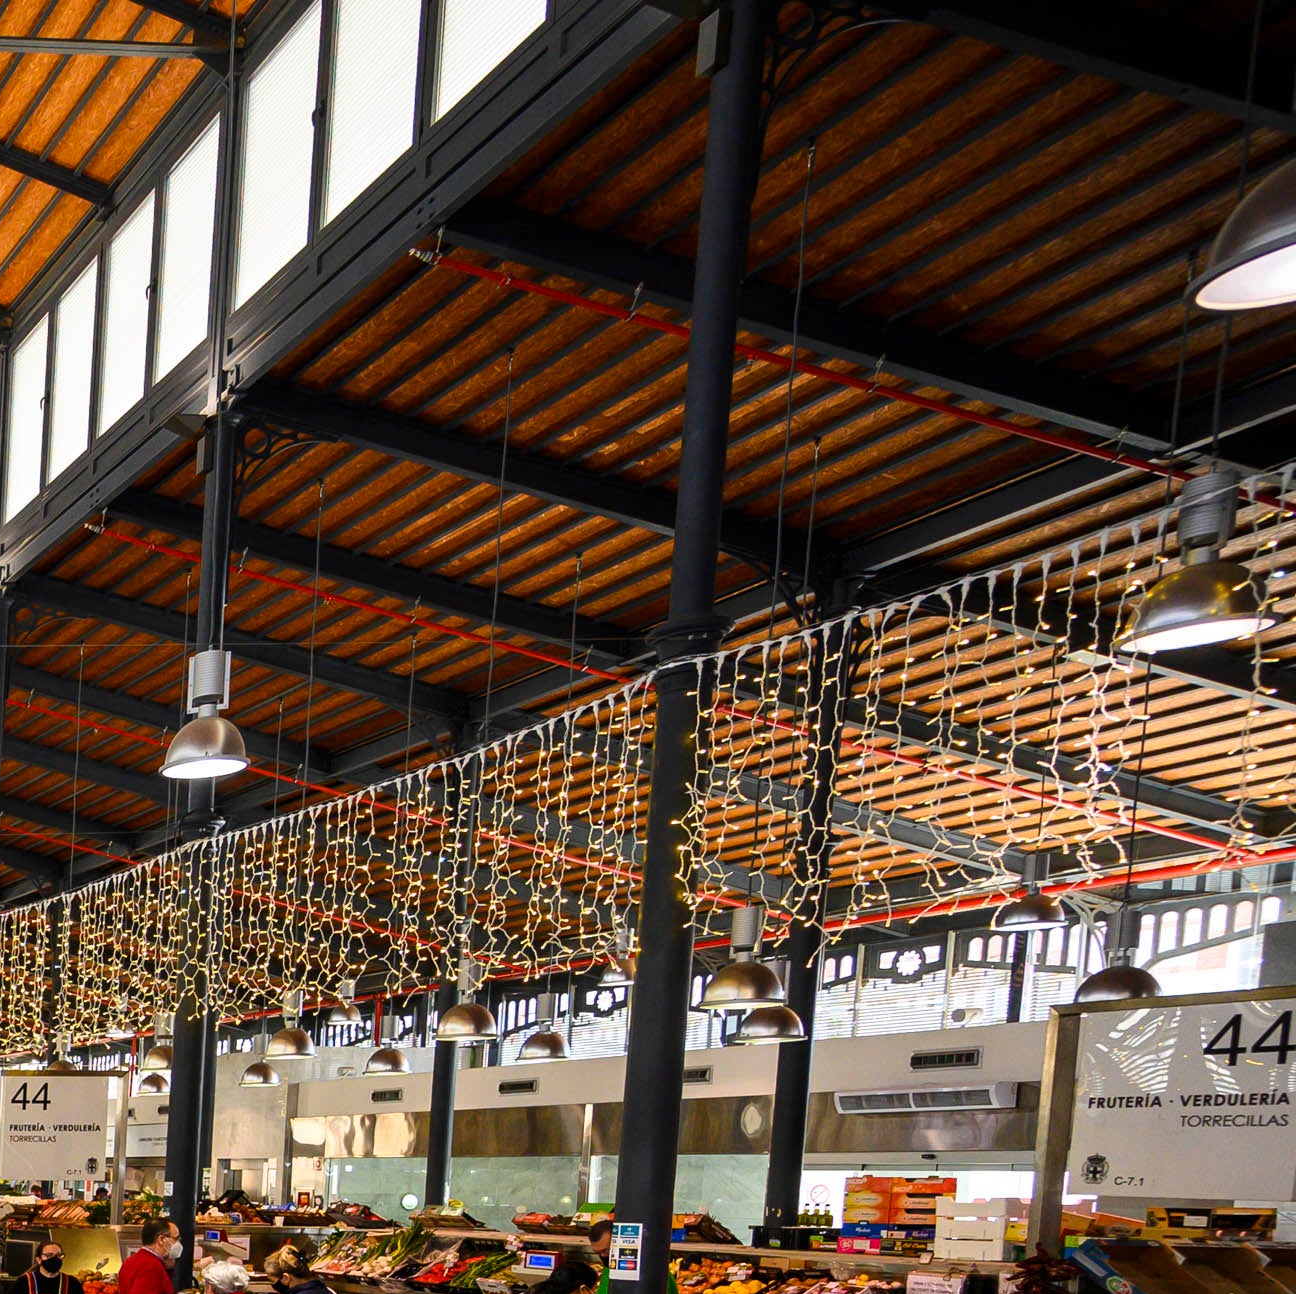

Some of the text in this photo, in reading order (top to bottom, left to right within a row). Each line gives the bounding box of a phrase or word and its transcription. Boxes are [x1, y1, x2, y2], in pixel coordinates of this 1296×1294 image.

[1203, 1010, 1296, 1066] 44
[10, 1082, 51, 1111] 44
[1088, 1093, 1162, 1109] FRUTERÍA
[1180, 1089, 1290, 1107] VERDULERÍA
[9, 1122, 45, 1132] FRUTERÍA
[52, 1122, 101, 1132] VERDULERÍA
[1180, 1114, 1289, 1128] TORRECILLAS
[9, 1134, 57, 1143] TORRECILLAS
[1114, 1176, 1144, 1187] C-7.1
